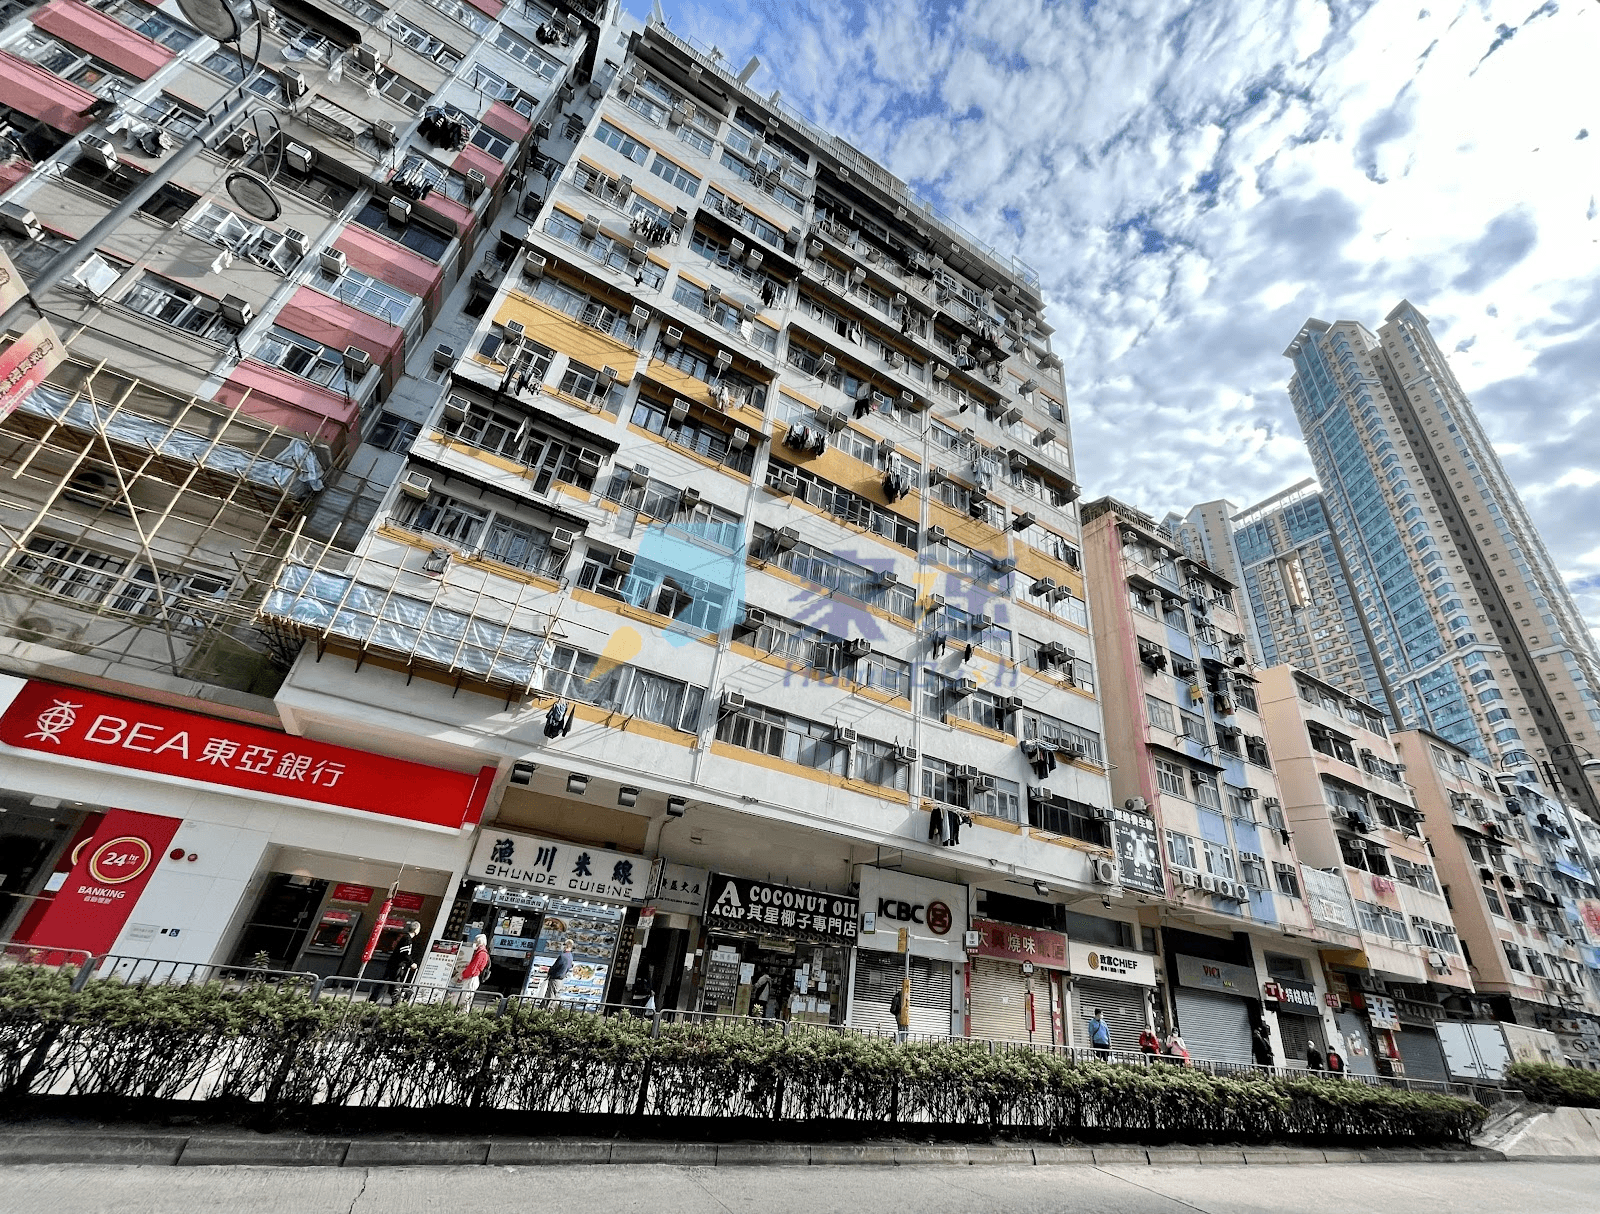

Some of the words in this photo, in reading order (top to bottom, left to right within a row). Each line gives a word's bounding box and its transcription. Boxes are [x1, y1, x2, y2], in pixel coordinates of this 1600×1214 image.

[84, 714, 190, 760] BEA
[196, 737, 347, 788] 東亞銀行
[102, 852, 128, 867] 24
[128, 853, 140, 862] hr
[490, 838, 634, 886] 漁川米線
[77, 886, 127, 899] BANKING
[485, 864, 558, 886] SHUNDE
[568, 878, 633, 899] CUISINE
[717, 880, 741, 907] A
[722, 906, 745, 919] CAP
[749, 885, 828, 914] COCONUT
[832, 900, 858, 919] OIL
[878, 897, 925, 924] ICBC
[746, 903, 857, 938] 其星椰子專門店
[1112, 955, 1138, 971] CHIEF
